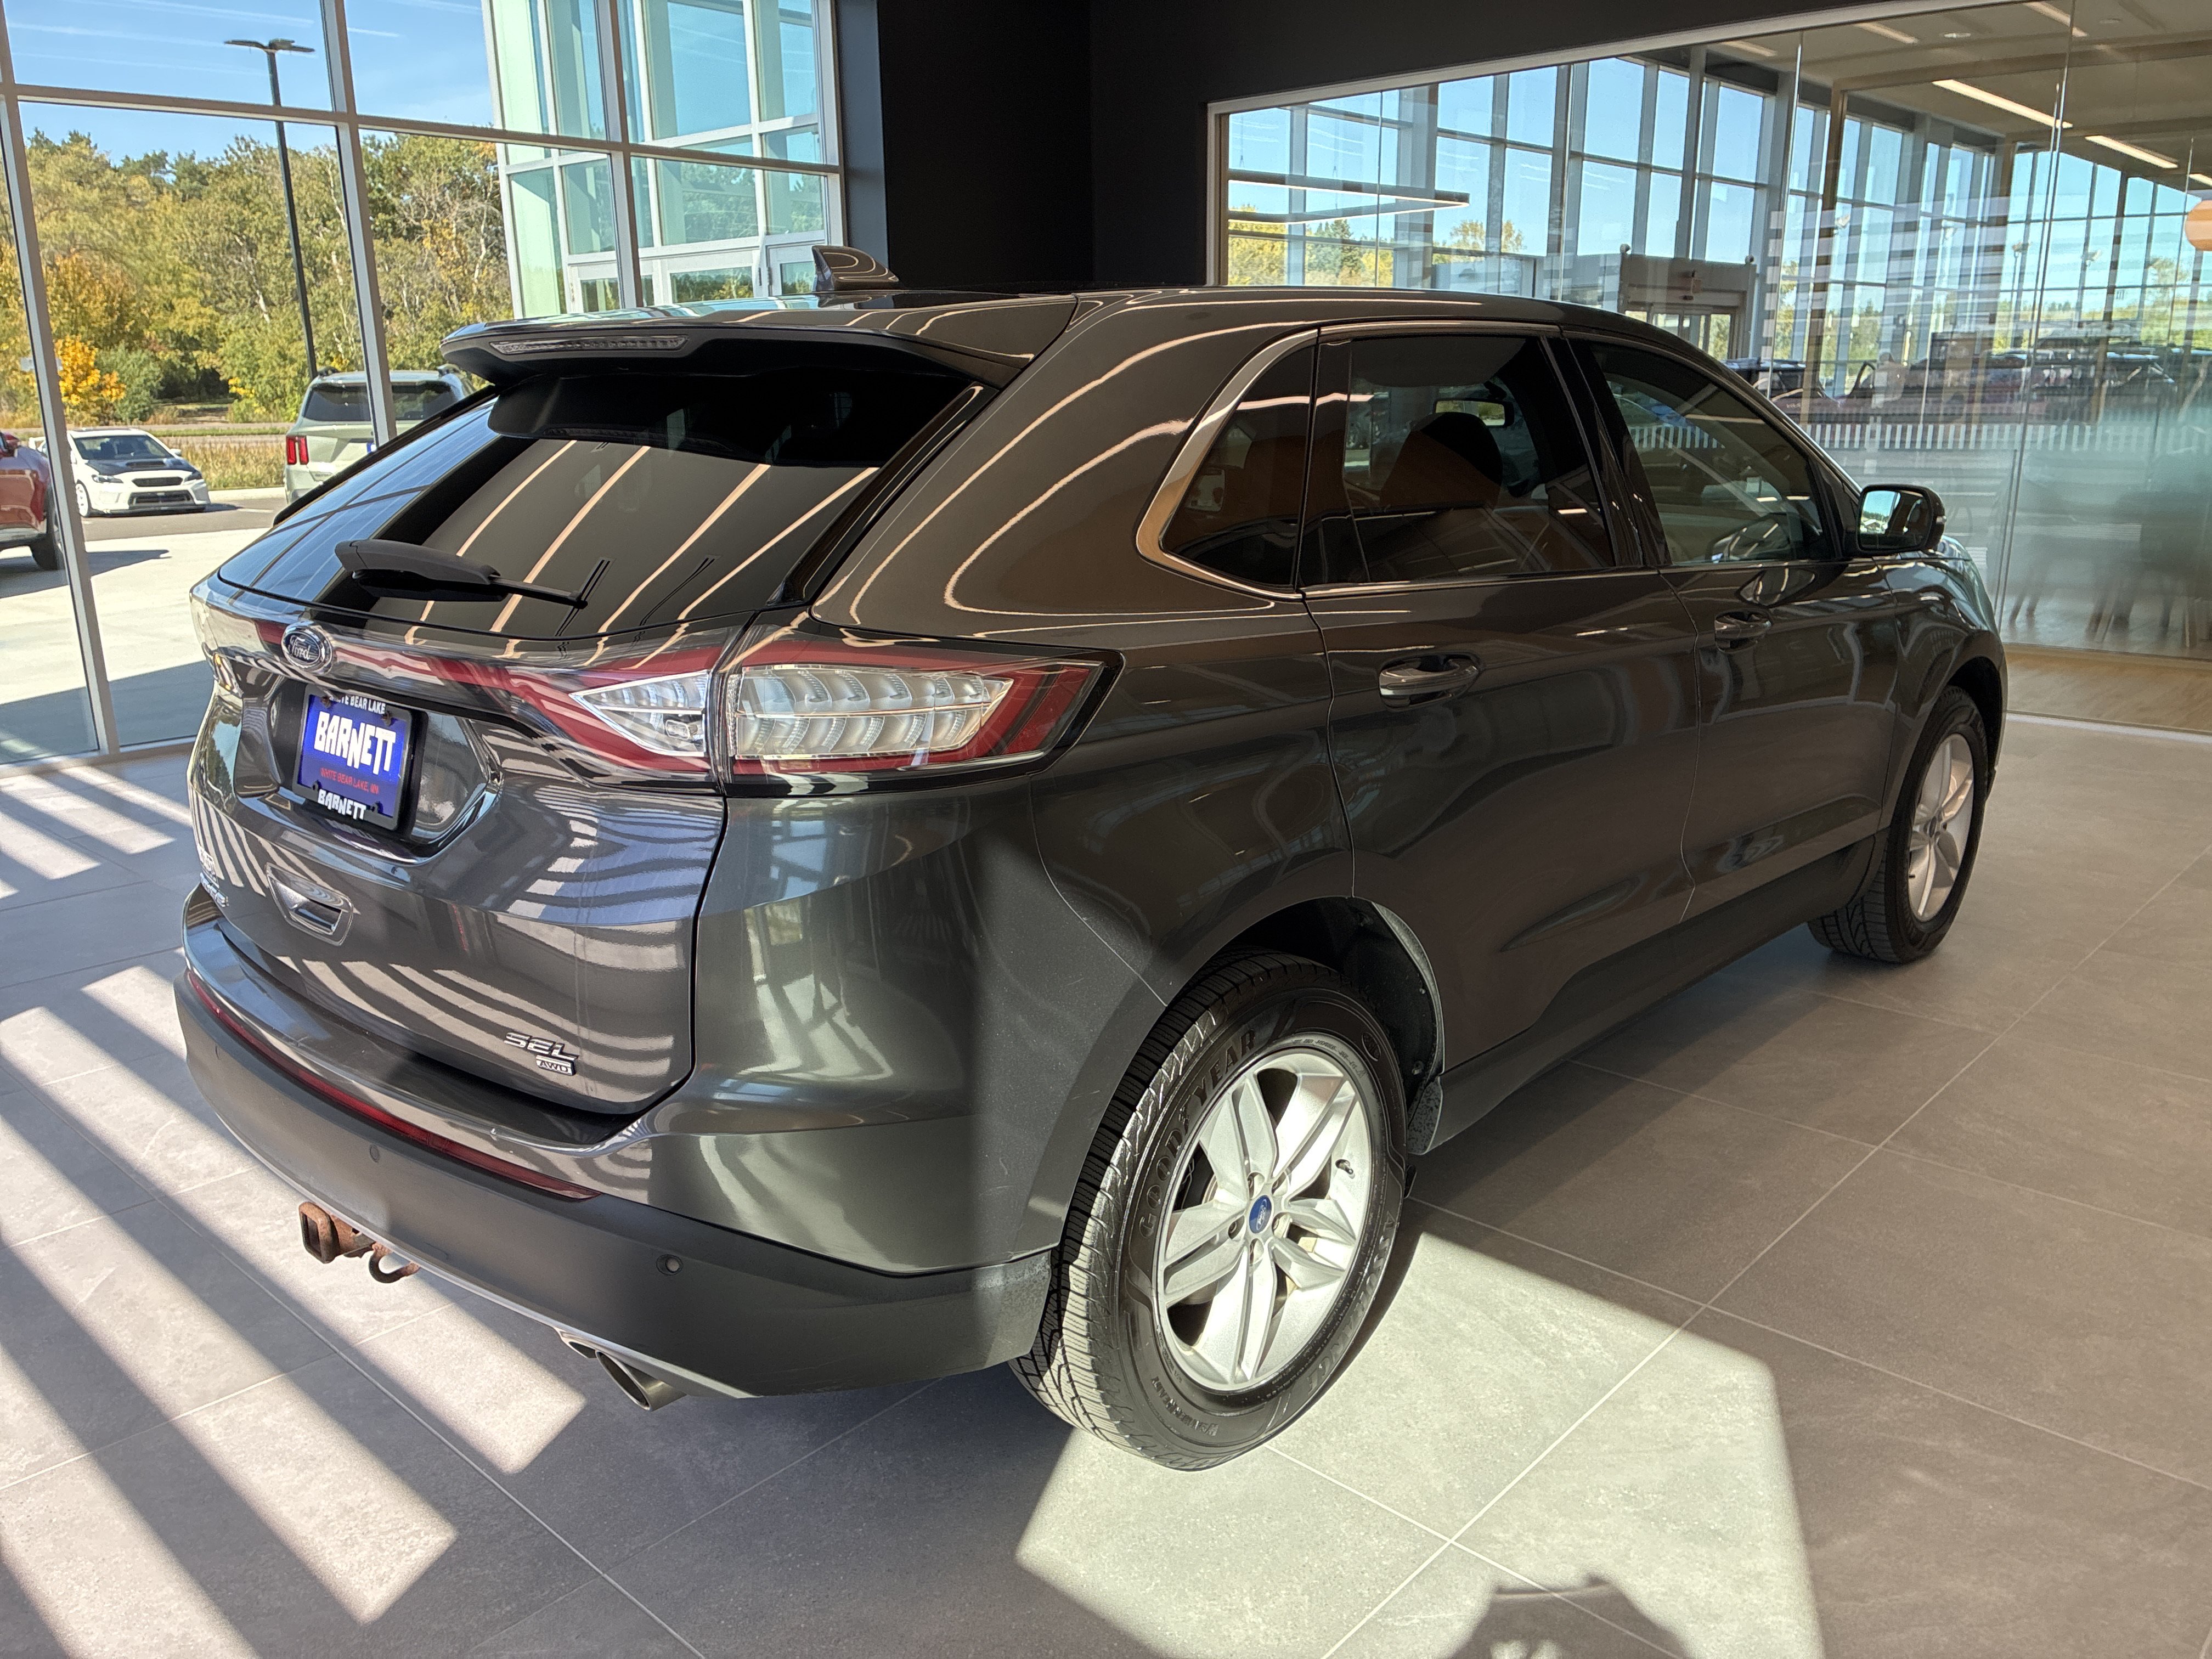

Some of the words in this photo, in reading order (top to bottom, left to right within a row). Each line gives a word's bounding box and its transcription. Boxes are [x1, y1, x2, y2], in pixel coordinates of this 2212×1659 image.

[350, 695, 368, 712] BEAR
[368, 699, 386, 715] LAKE
[314, 711, 396, 775] BARNETT
[317, 788, 366, 820] BARNETT
[504, 1032, 579, 1061] SEL
[539, 1061, 569, 1073] AWD
